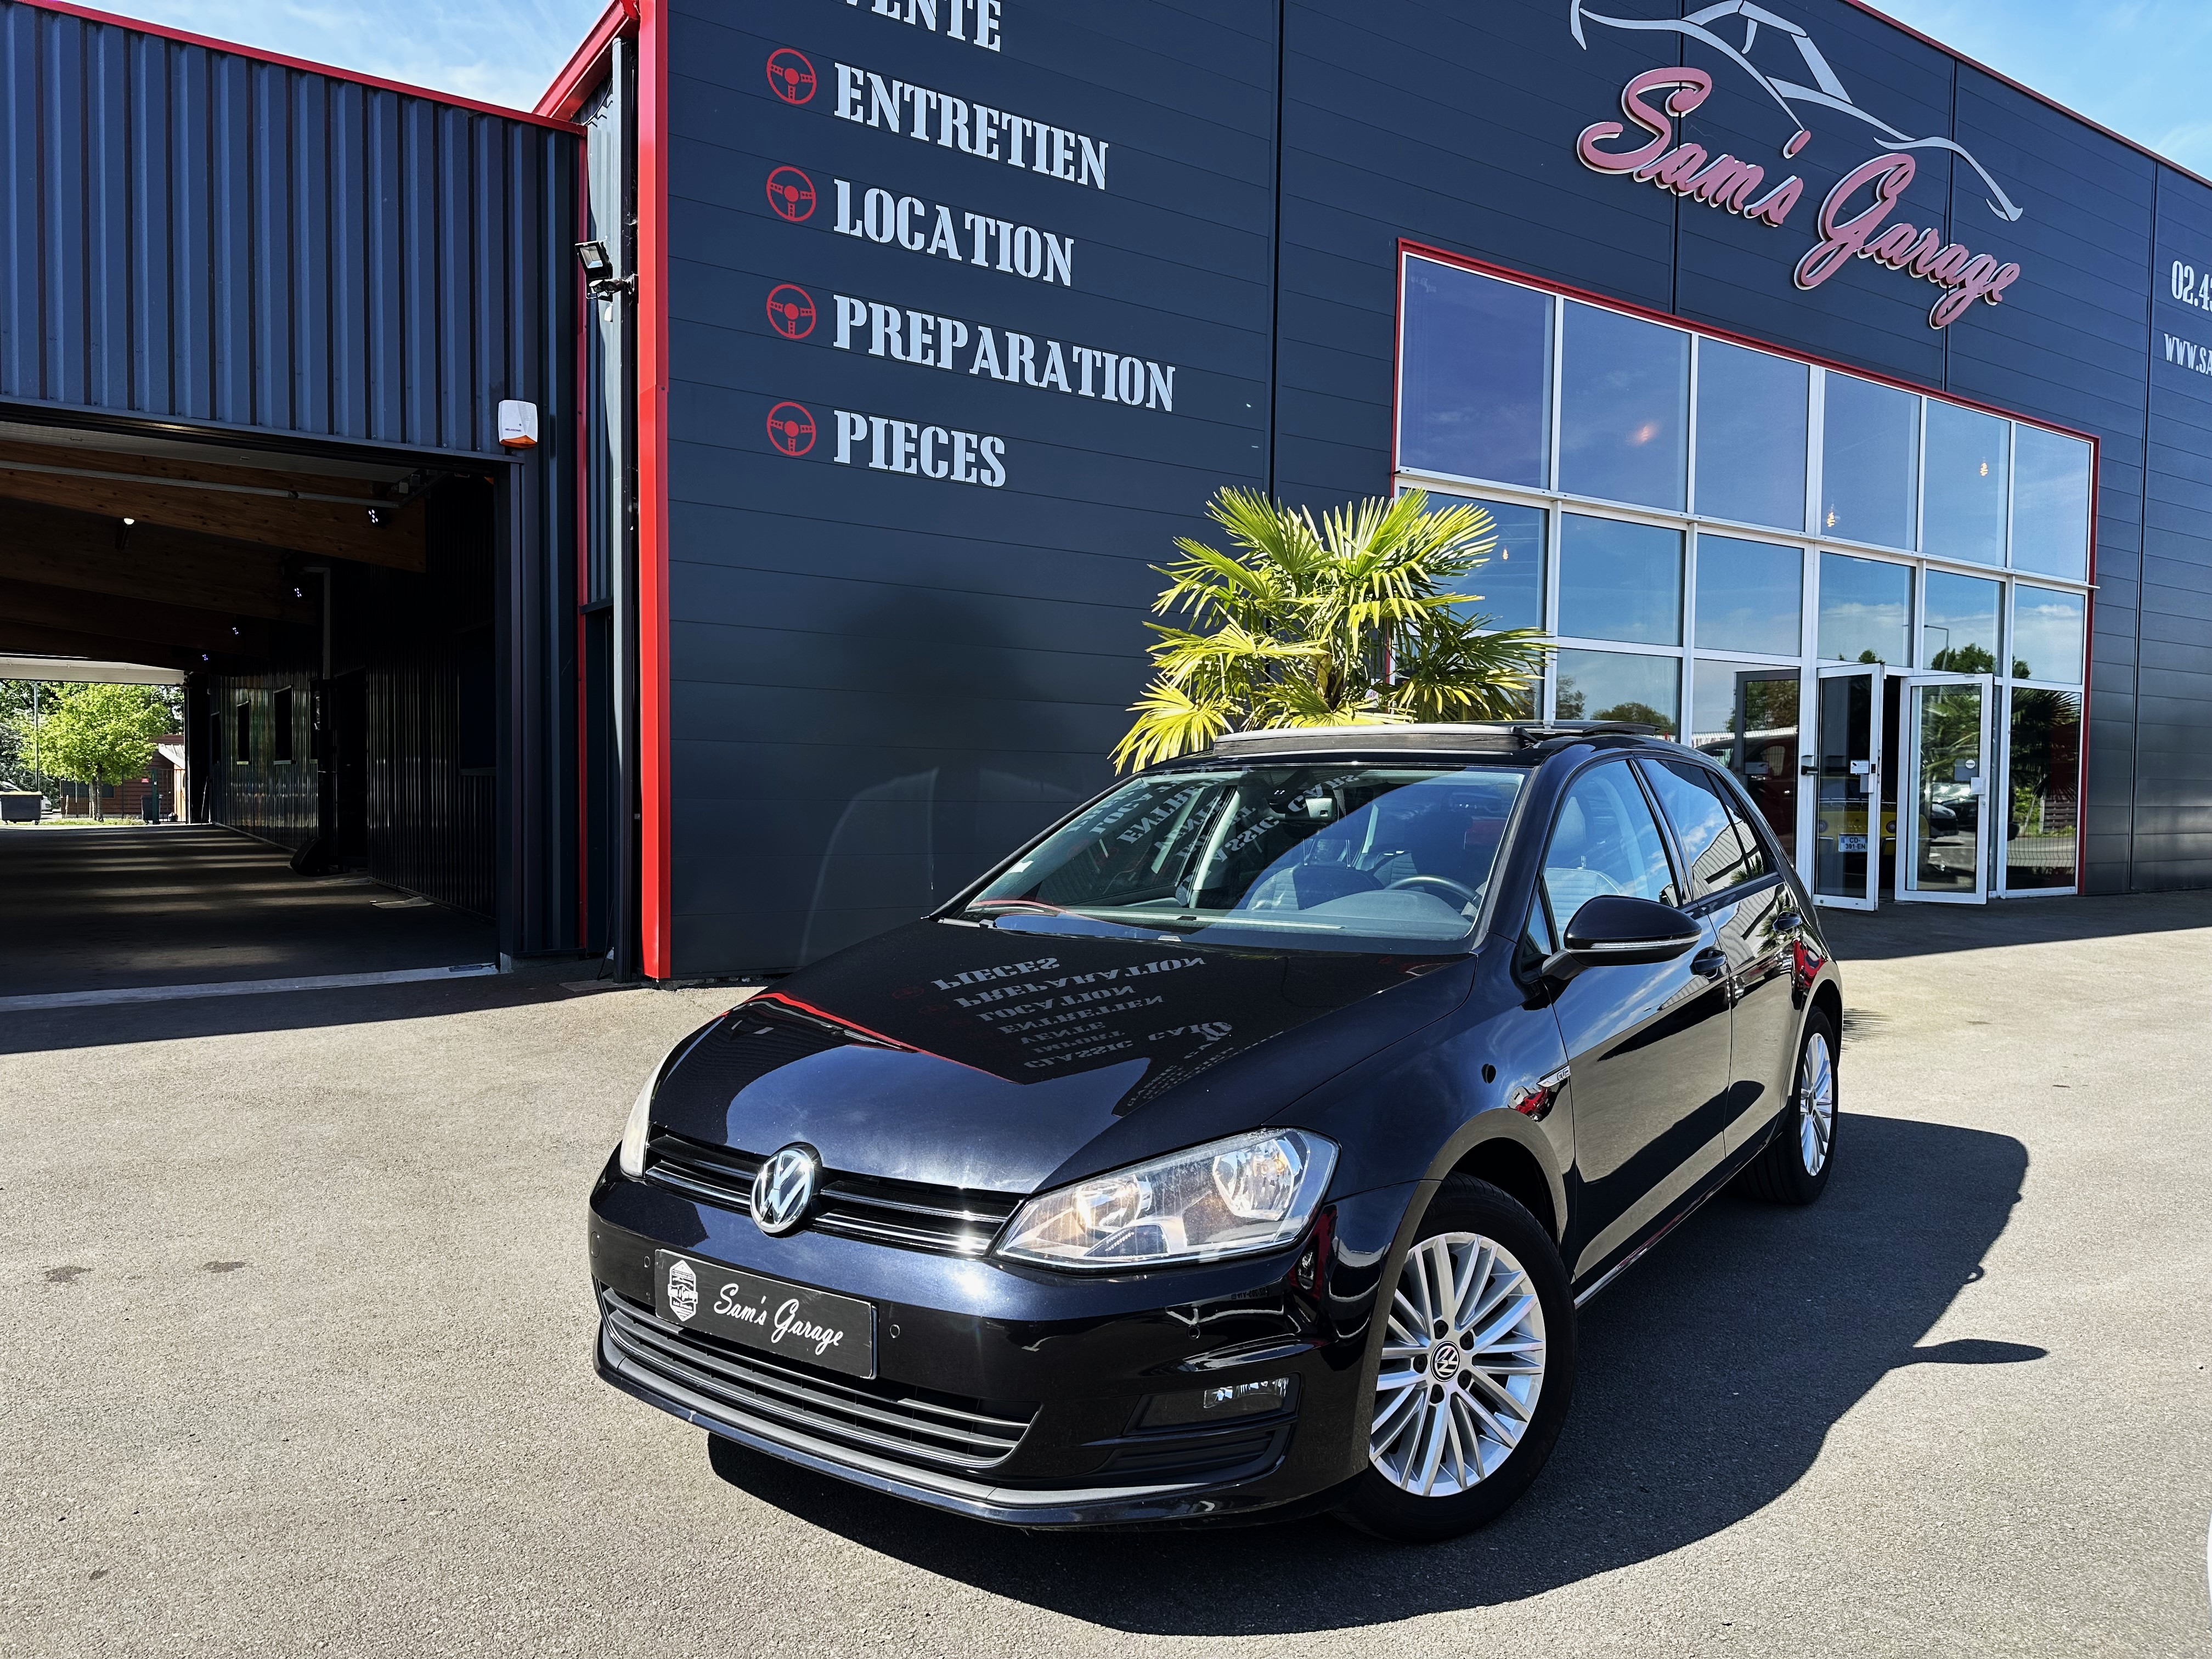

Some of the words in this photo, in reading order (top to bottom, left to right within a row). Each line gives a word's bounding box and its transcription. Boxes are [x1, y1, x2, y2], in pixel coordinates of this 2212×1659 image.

[847, 0, 1001, 52] NTE
[834, 62, 1109, 190] ENTRETIEN
[833, 178, 1075, 286] LOCATION
[1577, 67, 1812, 227] Sam's
[1794, 153, 2021, 330] Garage
[2171, 260, 2212, 312] 02.4
[833, 294, 1176, 412] PREPARATION
[833, 410, 1006, 487] PIECES
[714, 1283, 767, 1325] Sam's
[771, 1299, 843, 1355] Garage
